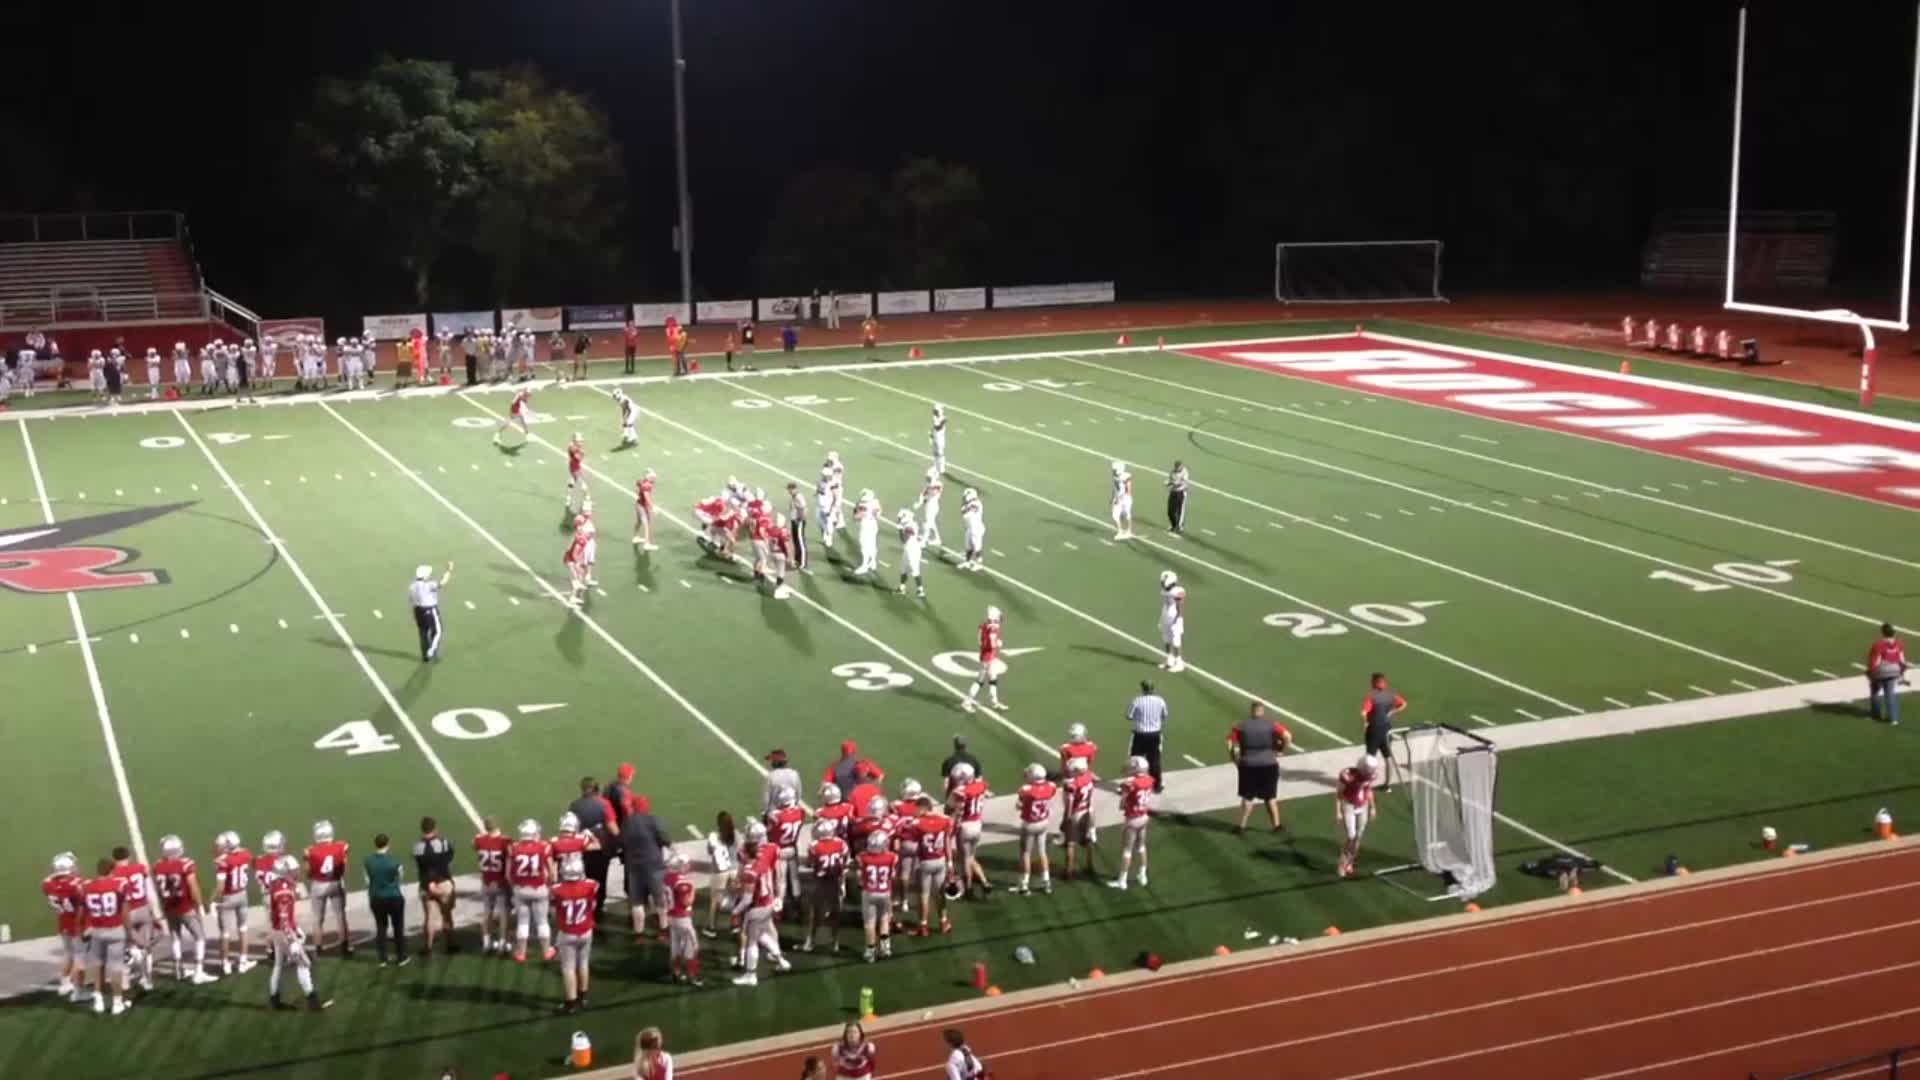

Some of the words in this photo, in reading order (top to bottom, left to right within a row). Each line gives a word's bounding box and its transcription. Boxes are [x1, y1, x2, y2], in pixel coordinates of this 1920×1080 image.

[1647, 561, 1794, 592] 10
[1263, 602, 1427, 638] 20
[831, 650, 1008, 691] 30
[313, 707, 512, 755] 40
[320, 855, 335, 875] 4
[479, 849, 503, 872] 25
[515, 854, 540, 877] 21
[866, 865, 891, 890] 33
